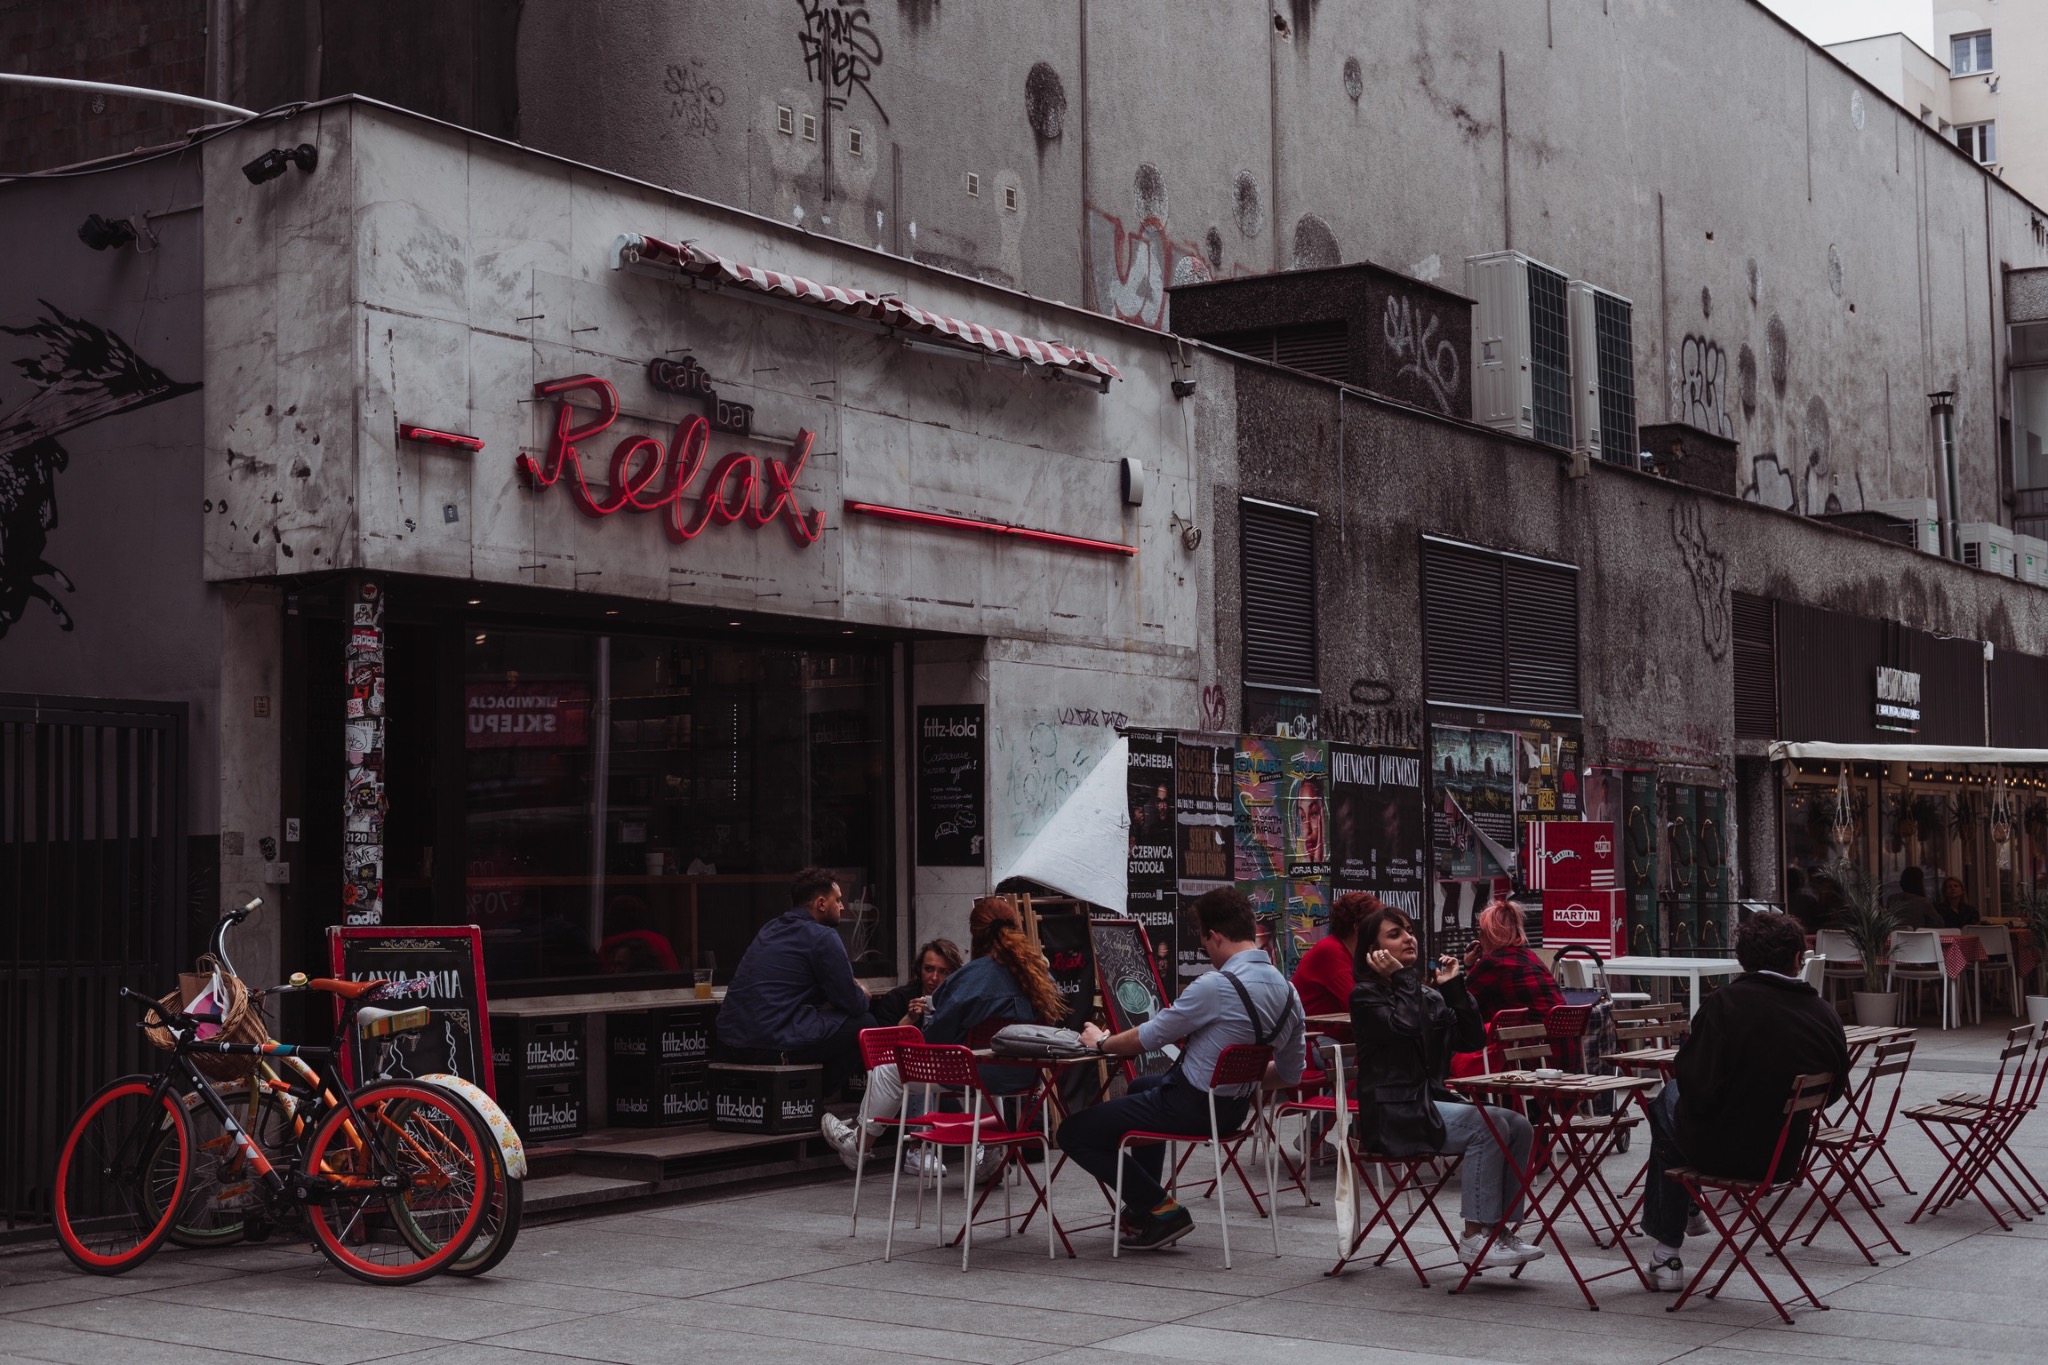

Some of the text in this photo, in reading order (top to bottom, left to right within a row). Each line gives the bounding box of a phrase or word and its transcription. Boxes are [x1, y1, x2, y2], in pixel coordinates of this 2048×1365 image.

[655, 359, 714, 395] cafe
[715, 391, 755, 430] bar
[516, 373, 827, 548] Relax
[1128, 752, 1173, 769] ORCHEEBA
[1178, 746, 1211, 773] SOCIAL
[1379, 753, 1420, 792] JOHNOSSI
[345, 832, 368, 843] 2120
[1131, 845, 1173, 859] CZERWCA
[1553, 850, 1575, 863] MARTINI
[1129, 861, 1165, 874] STODOŁA
[1130, 891, 1156, 899] STODOŁA
[346, 911, 381, 925] radio
[1555, 911, 1598, 921] MARTINI
[416, 969, 464, 999] DNIA
[614, 1036, 646, 1052] fritz-kola
[661, 1030, 706, 1052] fritz-kola
[526, 1040, 576, 1064] fritz-kola
[616, 1097, 648, 1113] fritz-kola
[662, 1091, 709, 1115] fritz-kola
[716, 1094, 764, 1118] fritz-kola
[781, 1099, 814, 1116] fritz-kola
[528, 1102, 577, 1126] fritz-kola
